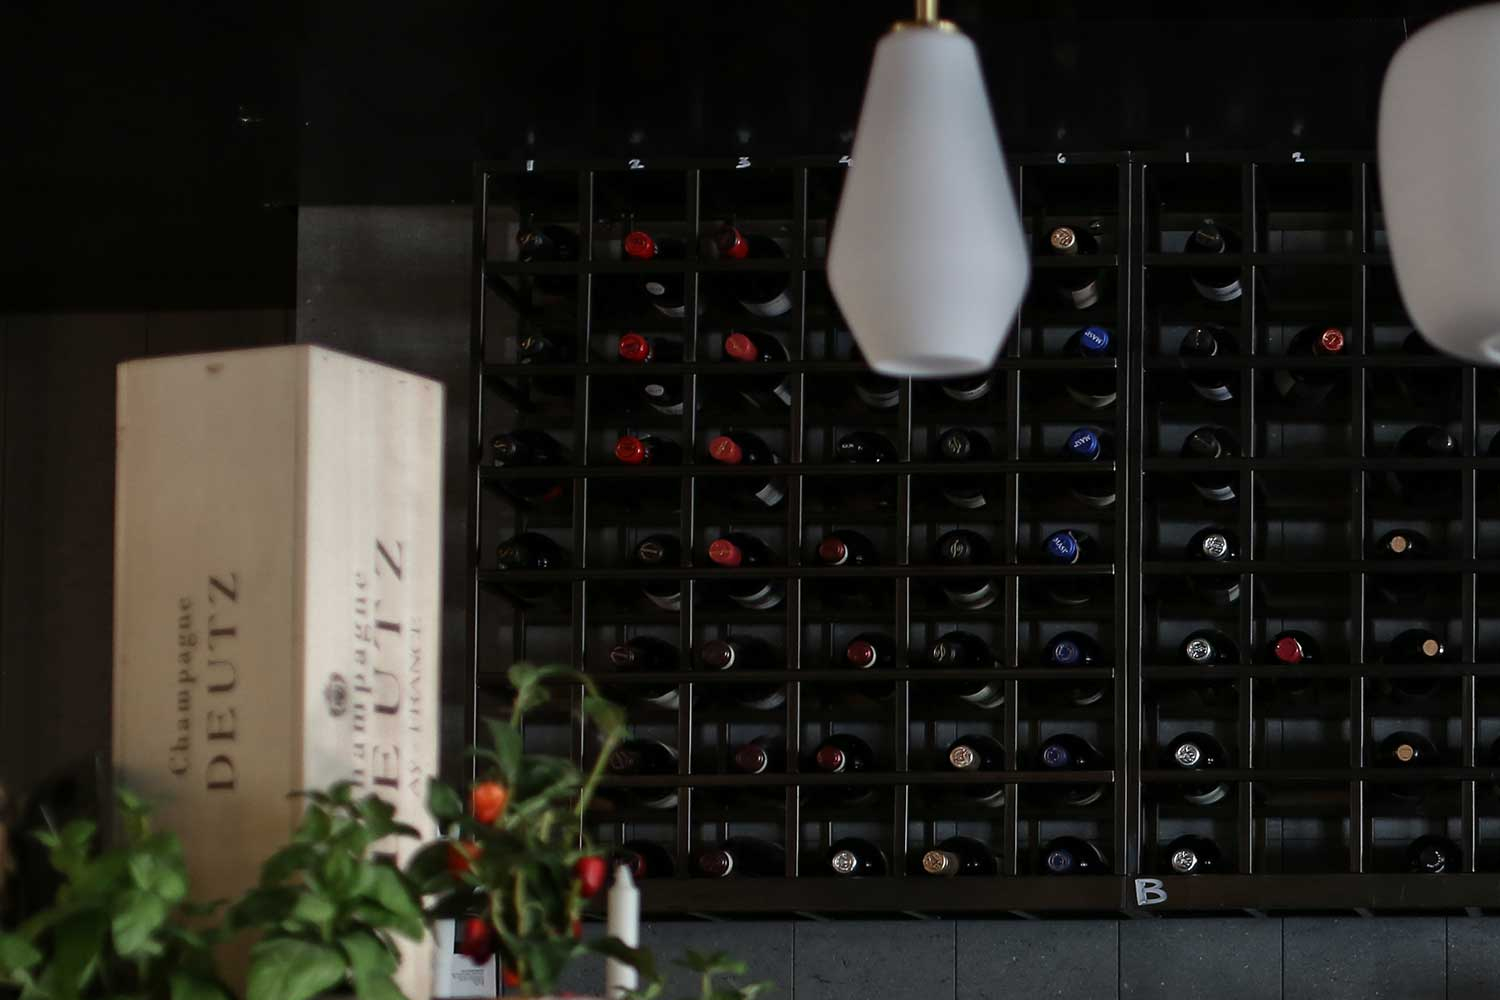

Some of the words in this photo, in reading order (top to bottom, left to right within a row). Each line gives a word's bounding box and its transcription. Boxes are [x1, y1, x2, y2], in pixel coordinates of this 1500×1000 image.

[628, 158, 645, 169] 2
[736, 156, 751, 169] 3
[1057, 152, 1067, 164] 6
[1292, 151, 1306, 163] 2
[169, 597, 198, 776] Champagne
[206, 572, 238, 791] DEUTZ
[353, 573, 373, 789] hampagne
[373, 540, 403, 866] EUTZ
[1135, 878, 1168, 906] B
